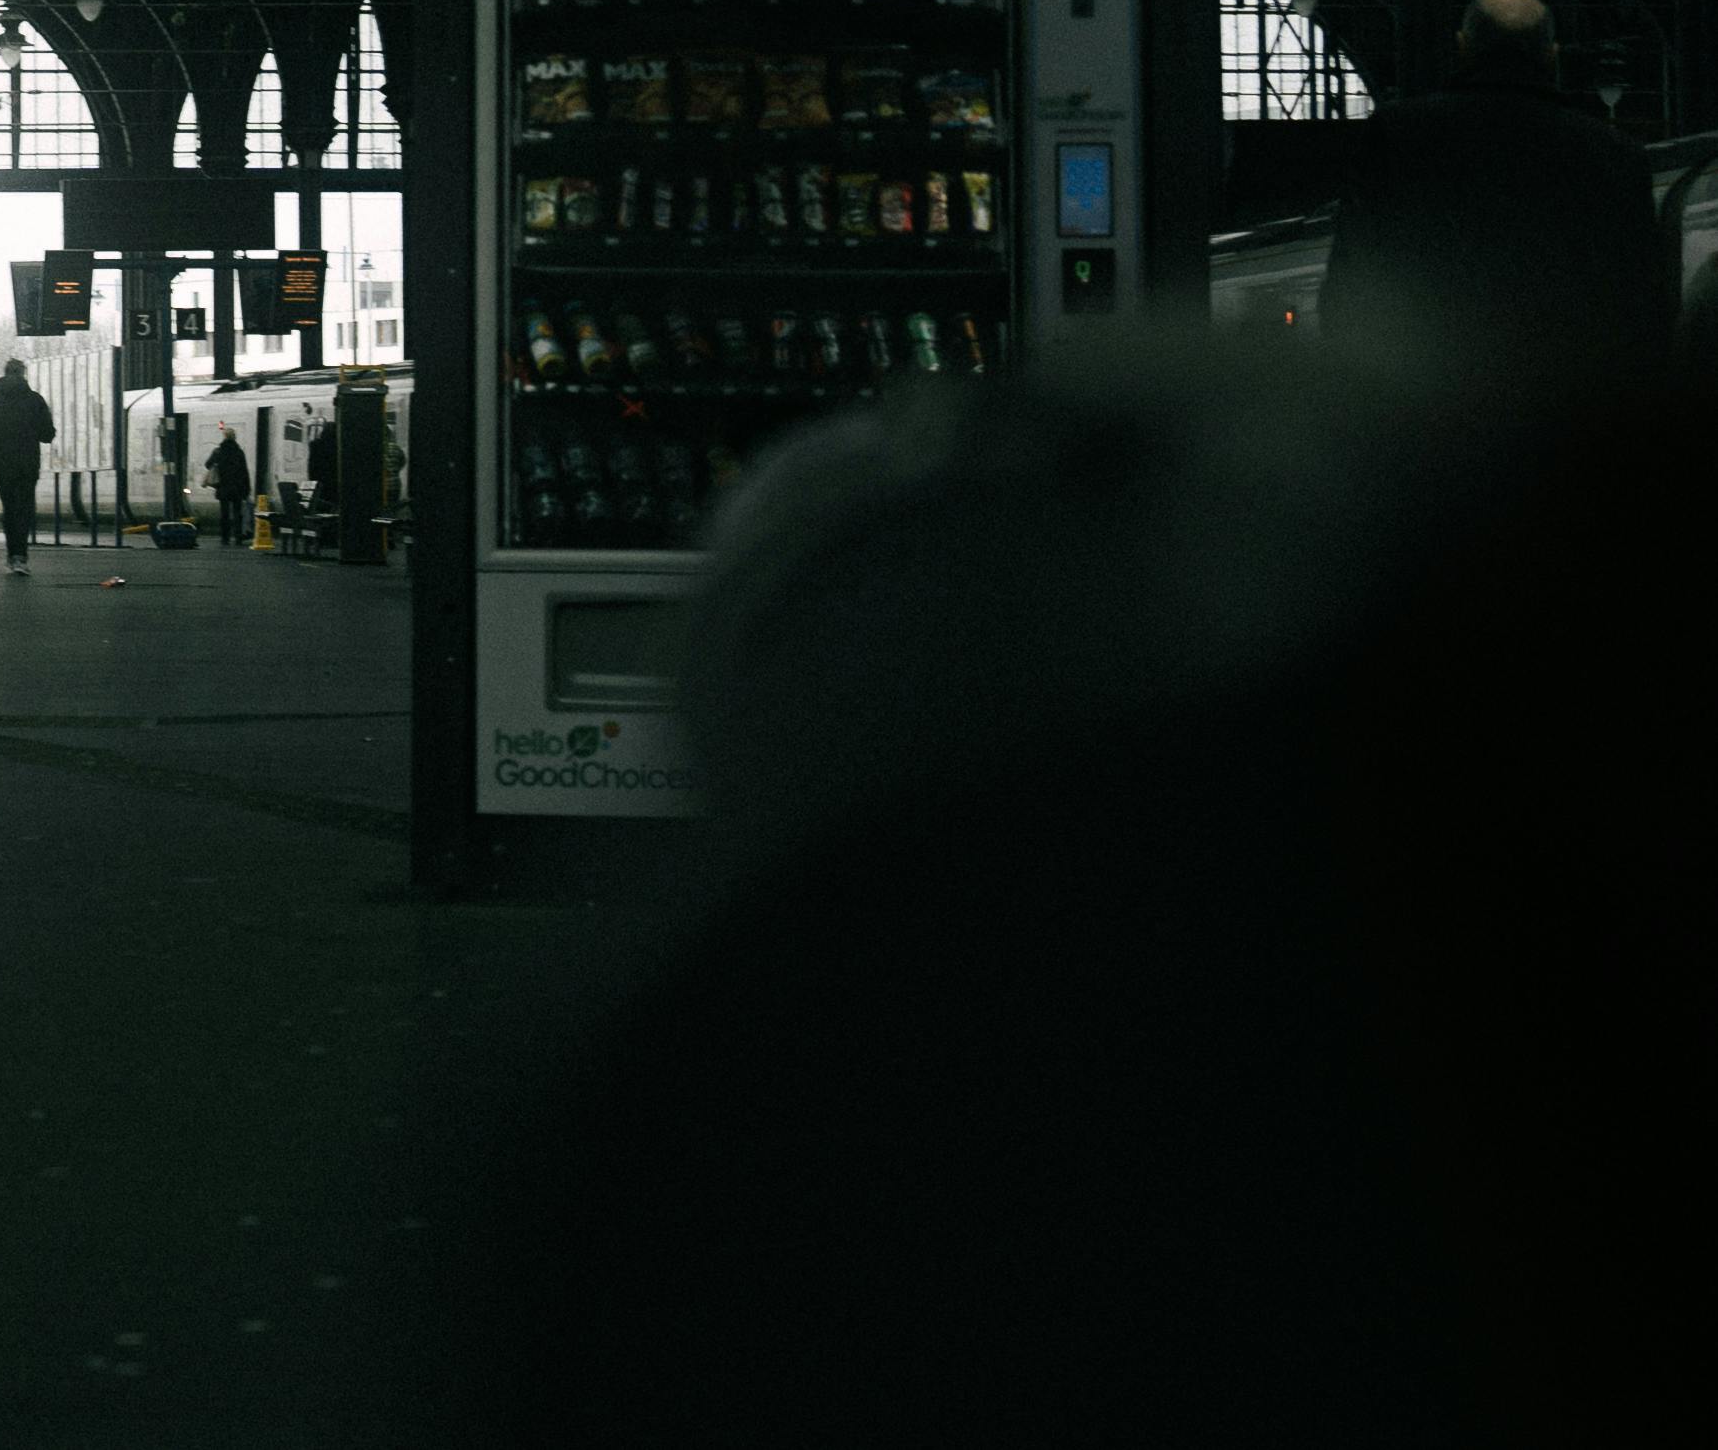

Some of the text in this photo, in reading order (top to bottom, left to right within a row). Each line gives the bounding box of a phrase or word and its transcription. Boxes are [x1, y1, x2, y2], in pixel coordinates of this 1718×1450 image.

[524, 58, 587, 83] MAX
[137, 314, 151, 337] 3
[182, 312, 201, 336] 4
[494, 727, 564, 757] hello
